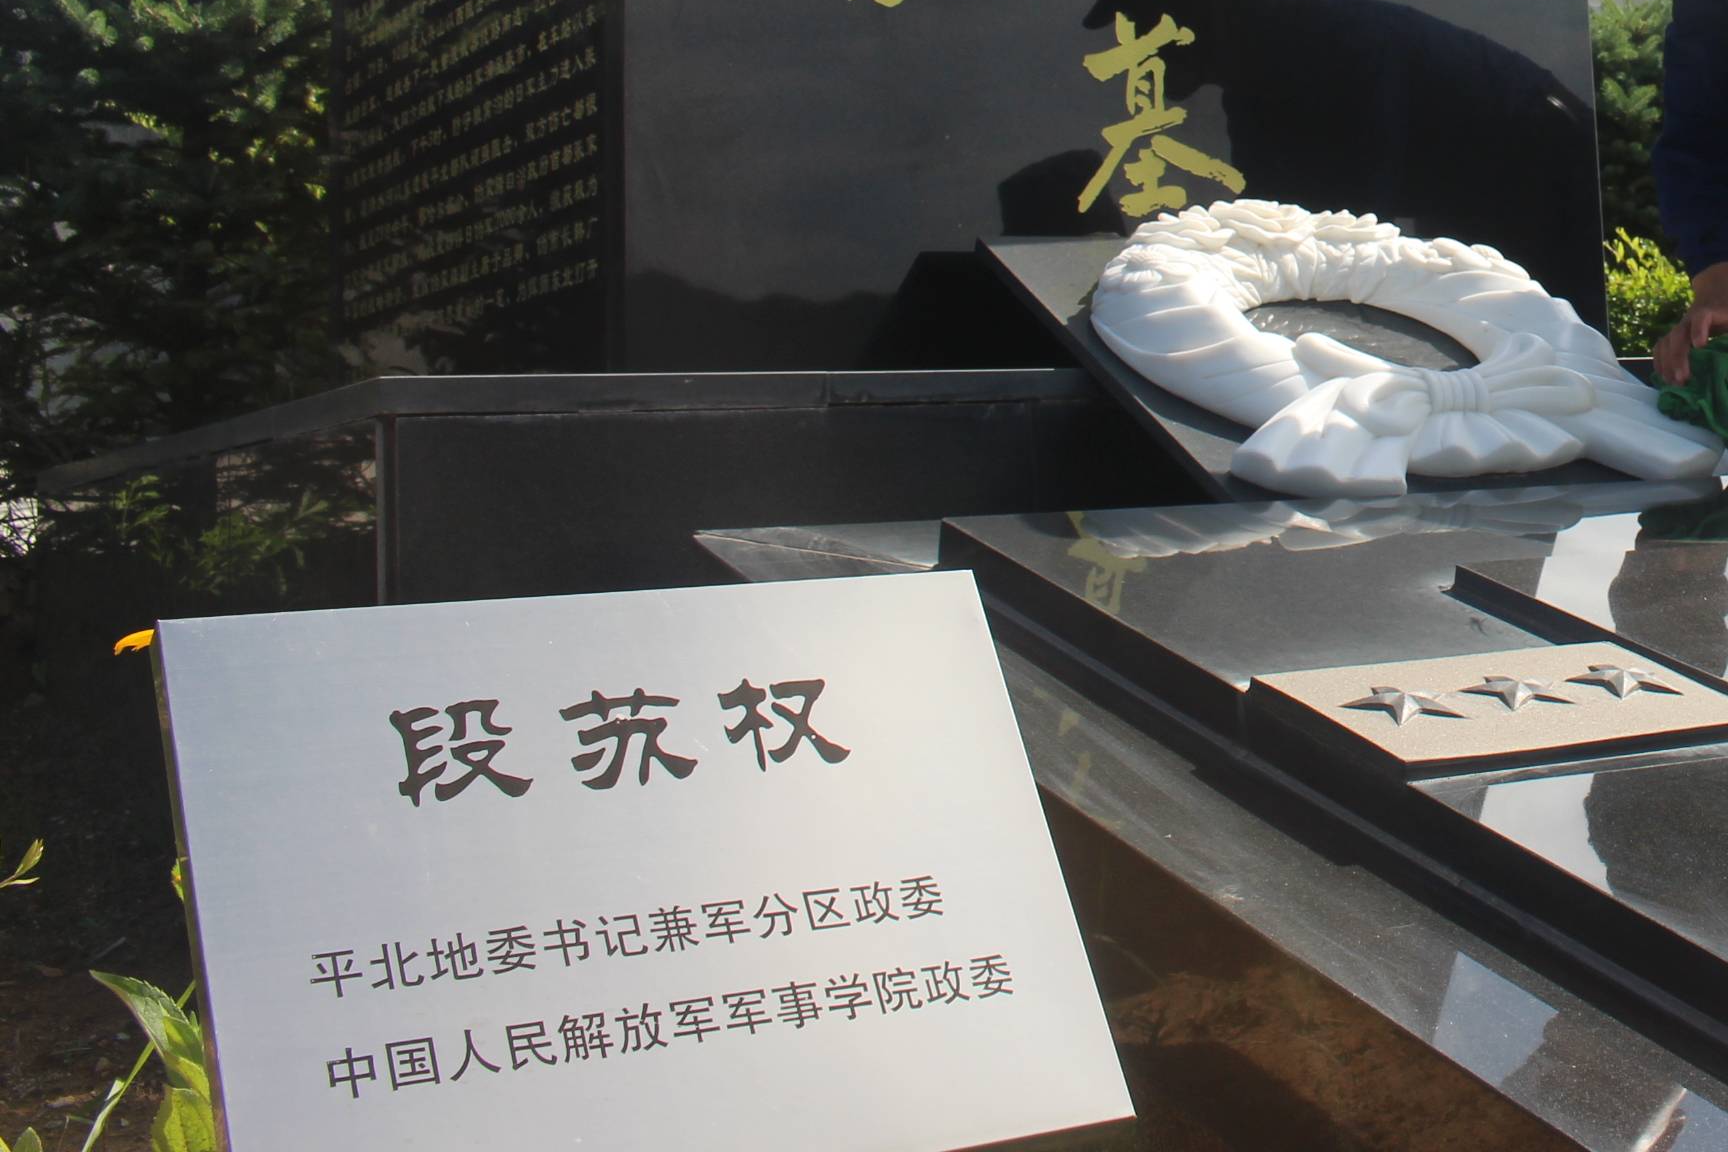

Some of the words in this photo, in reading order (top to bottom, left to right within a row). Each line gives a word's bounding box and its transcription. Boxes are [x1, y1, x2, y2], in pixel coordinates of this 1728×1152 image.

[389, 678, 851, 808] 段苏权
[309, 874, 946, 999] 平北地委书记兼军分区政委
[325, 954, 1015, 1101] 中国人民解放军军事学院政委
